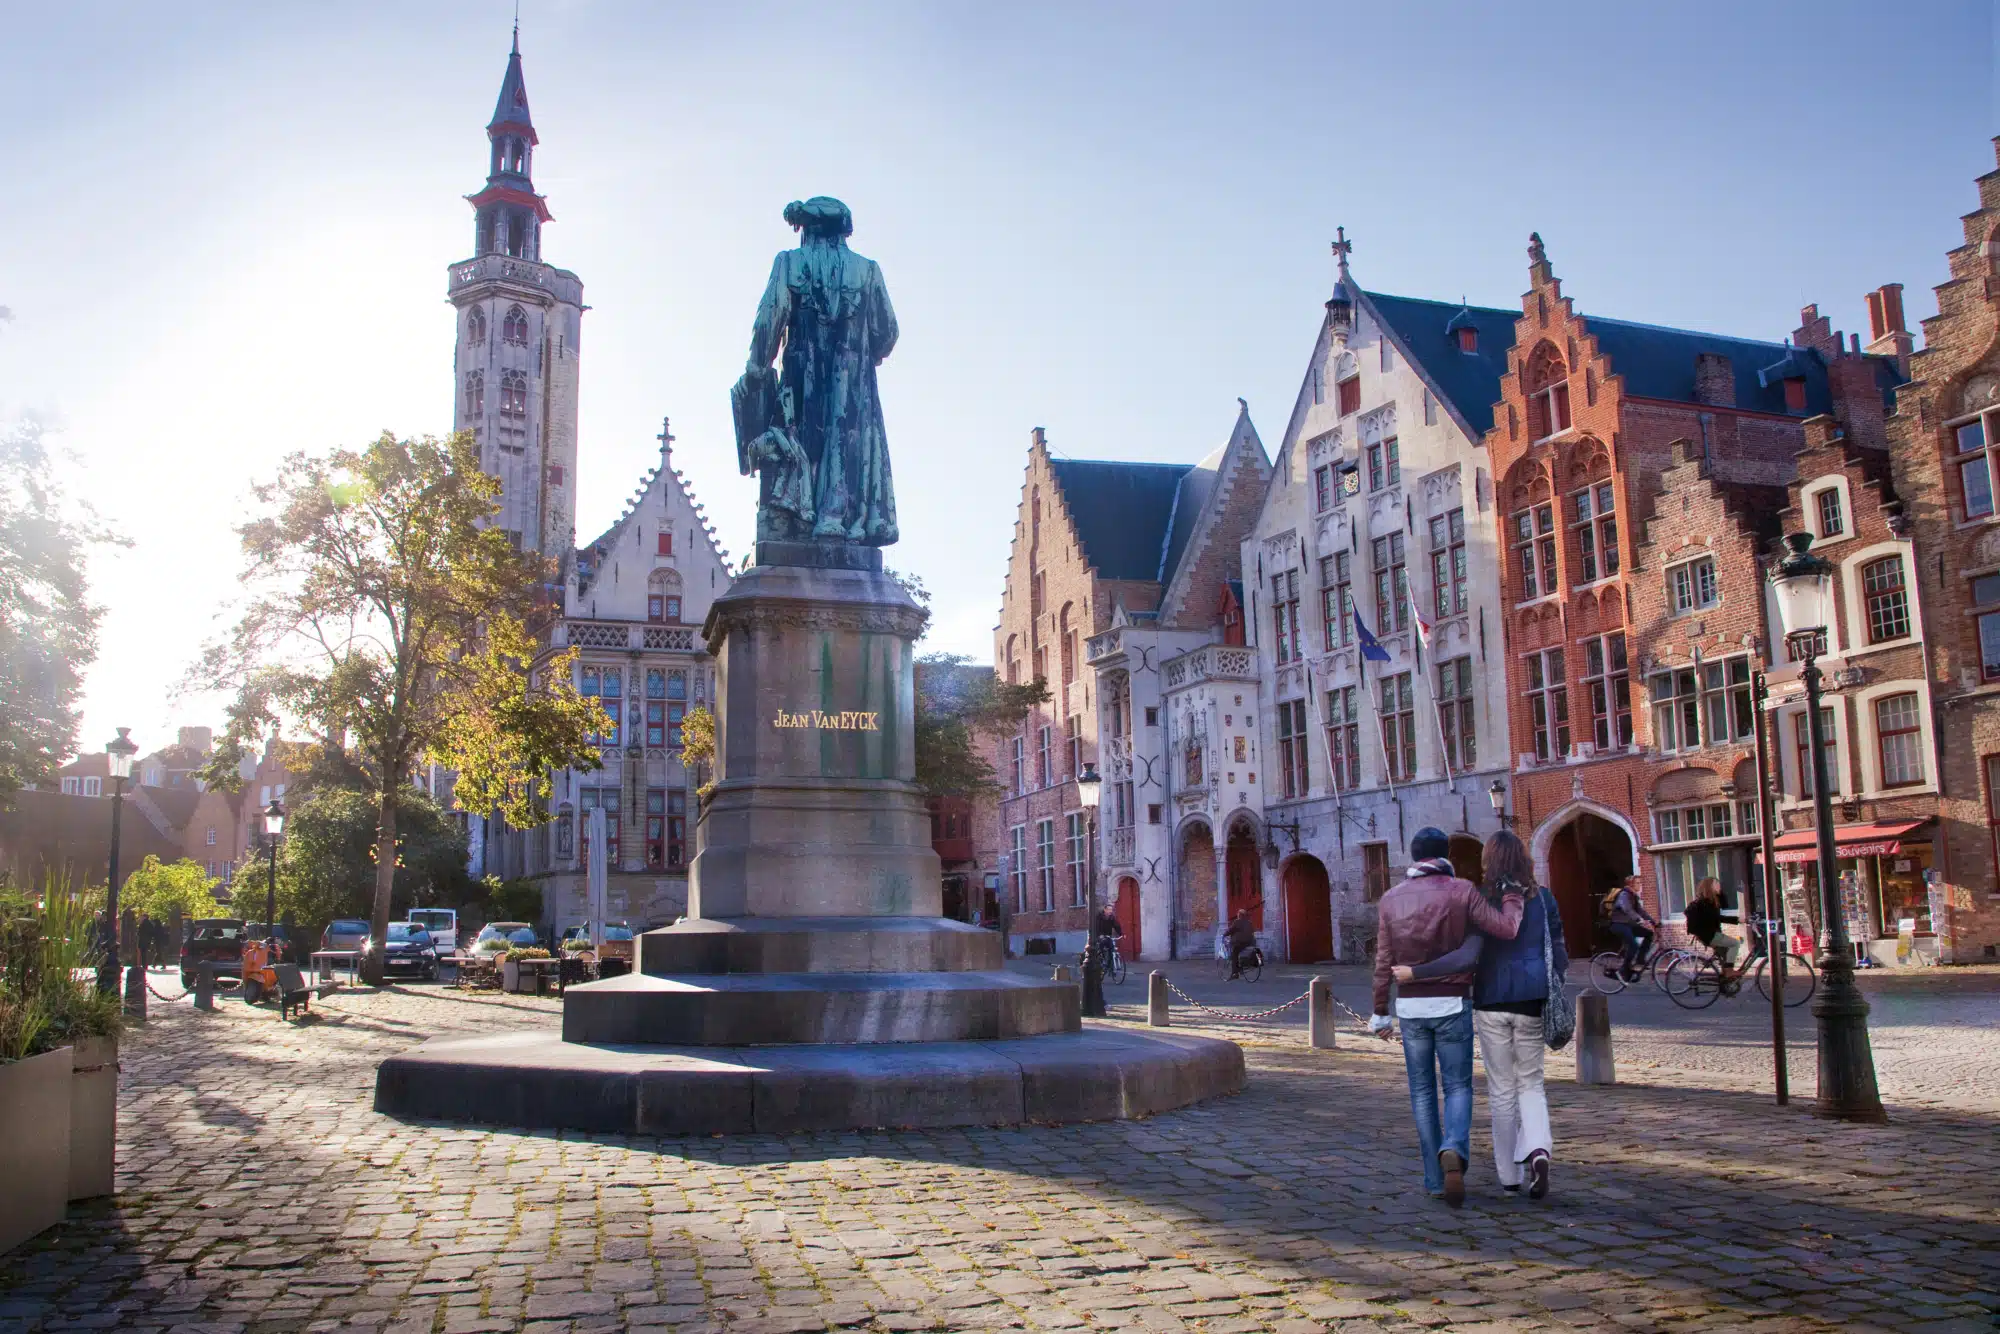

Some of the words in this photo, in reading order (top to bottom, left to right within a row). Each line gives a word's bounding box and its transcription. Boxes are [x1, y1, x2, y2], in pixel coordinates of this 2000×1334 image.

[774, 709, 809, 728] JEAN
[1774, 851, 1805, 861] ranten
[1835, 844, 1886, 857] Souvenirs
